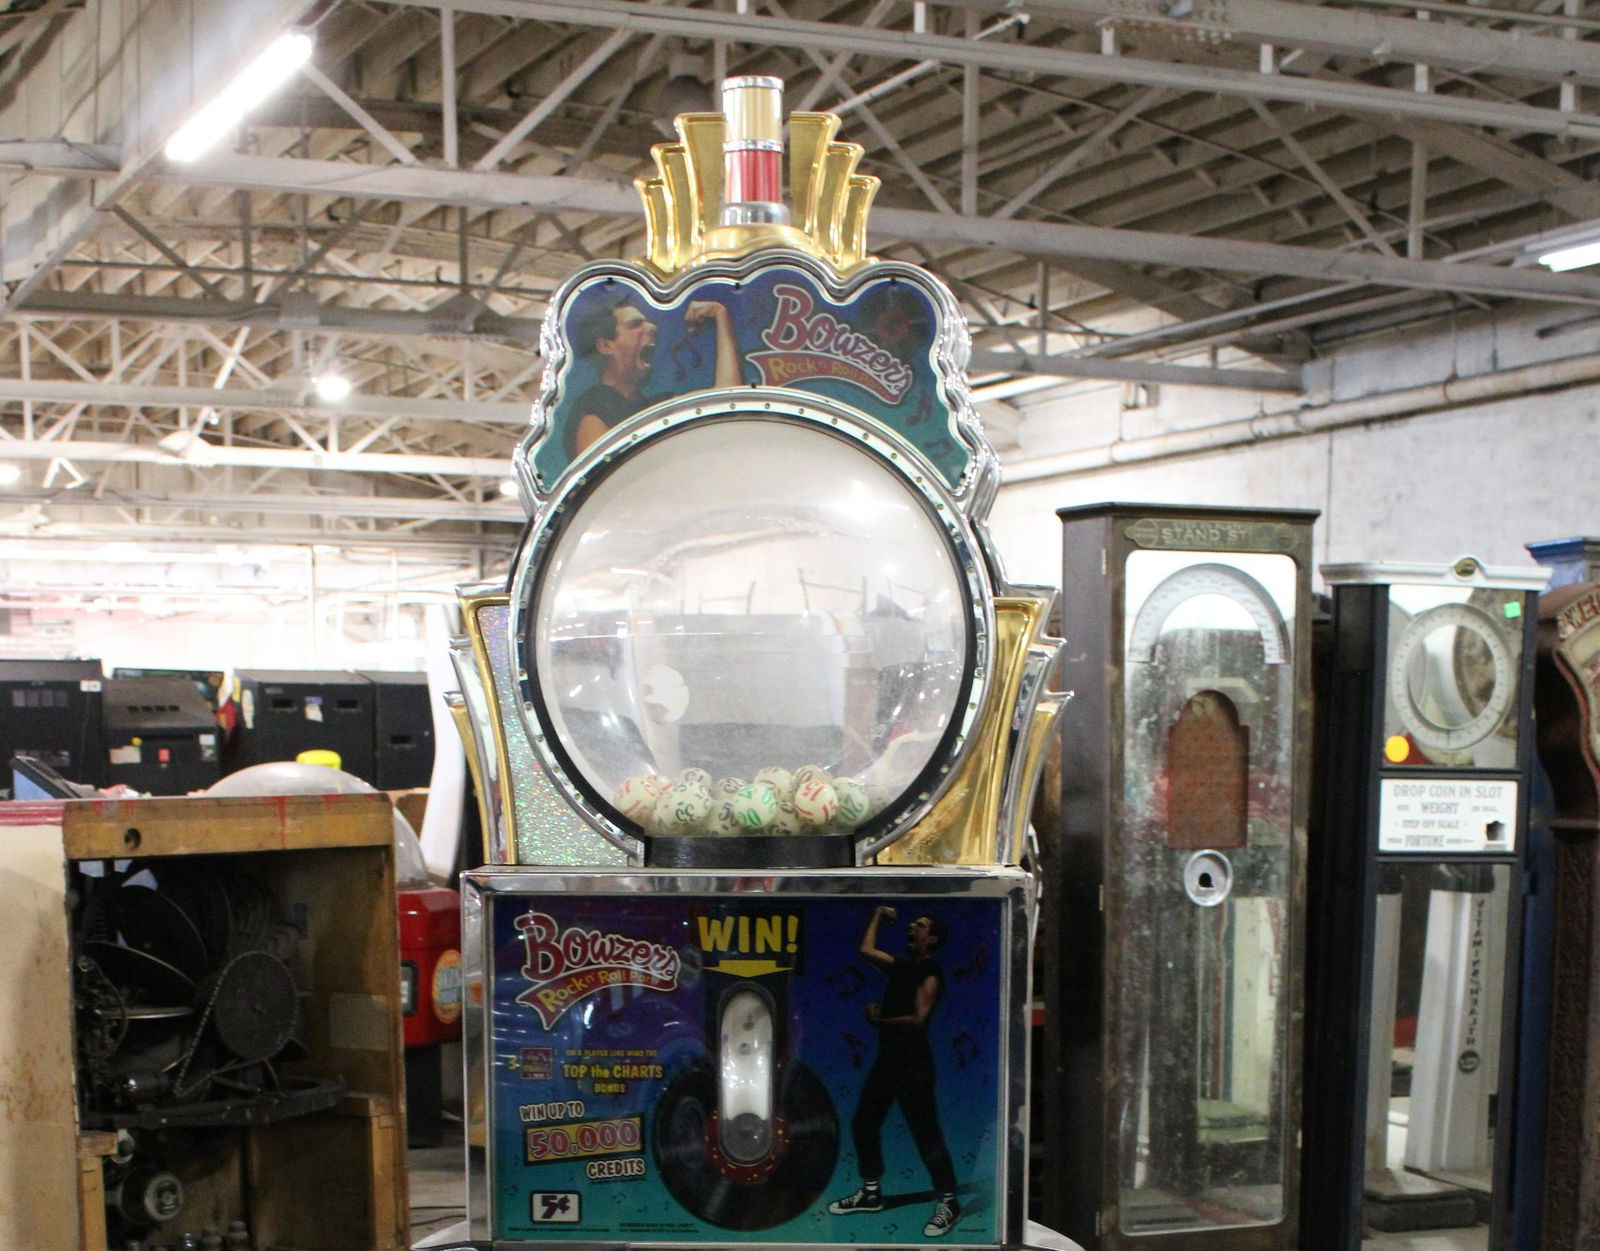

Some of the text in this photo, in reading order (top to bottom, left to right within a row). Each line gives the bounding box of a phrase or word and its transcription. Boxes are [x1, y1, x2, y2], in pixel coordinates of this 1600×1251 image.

[761, 284, 913, 396] Bowzer's
[768, 357, 818, 381] Rock
[1161, 526, 1221, 543] STAND
[1393, 784, 1504, 799] DROP COIN IN SLOT
[1420, 802, 1460, 815] WEIGHT
[1402, 819, 1422, 829] STEP
[1437, 820, 1461, 829] SCALE
[1404, 834, 1445, 847] FORTUNE
[697, 914, 799, 954] WIN!
[513, 912, 681, 983] Bowzer's
[537, 979, 588, 1013] Rock
[600, 969, 627, 985] Roll
[563, 1064, 588, 1078] TOP
[591, 1064, 610, 1078] the
[613, 1064, 663, 1079] CHARTS
[594, 1083, 626, 1094] BONUS
[520, 1101, 585, 1122] WIN UP TO
[586, 1158, 646, 1179] CREDITS
